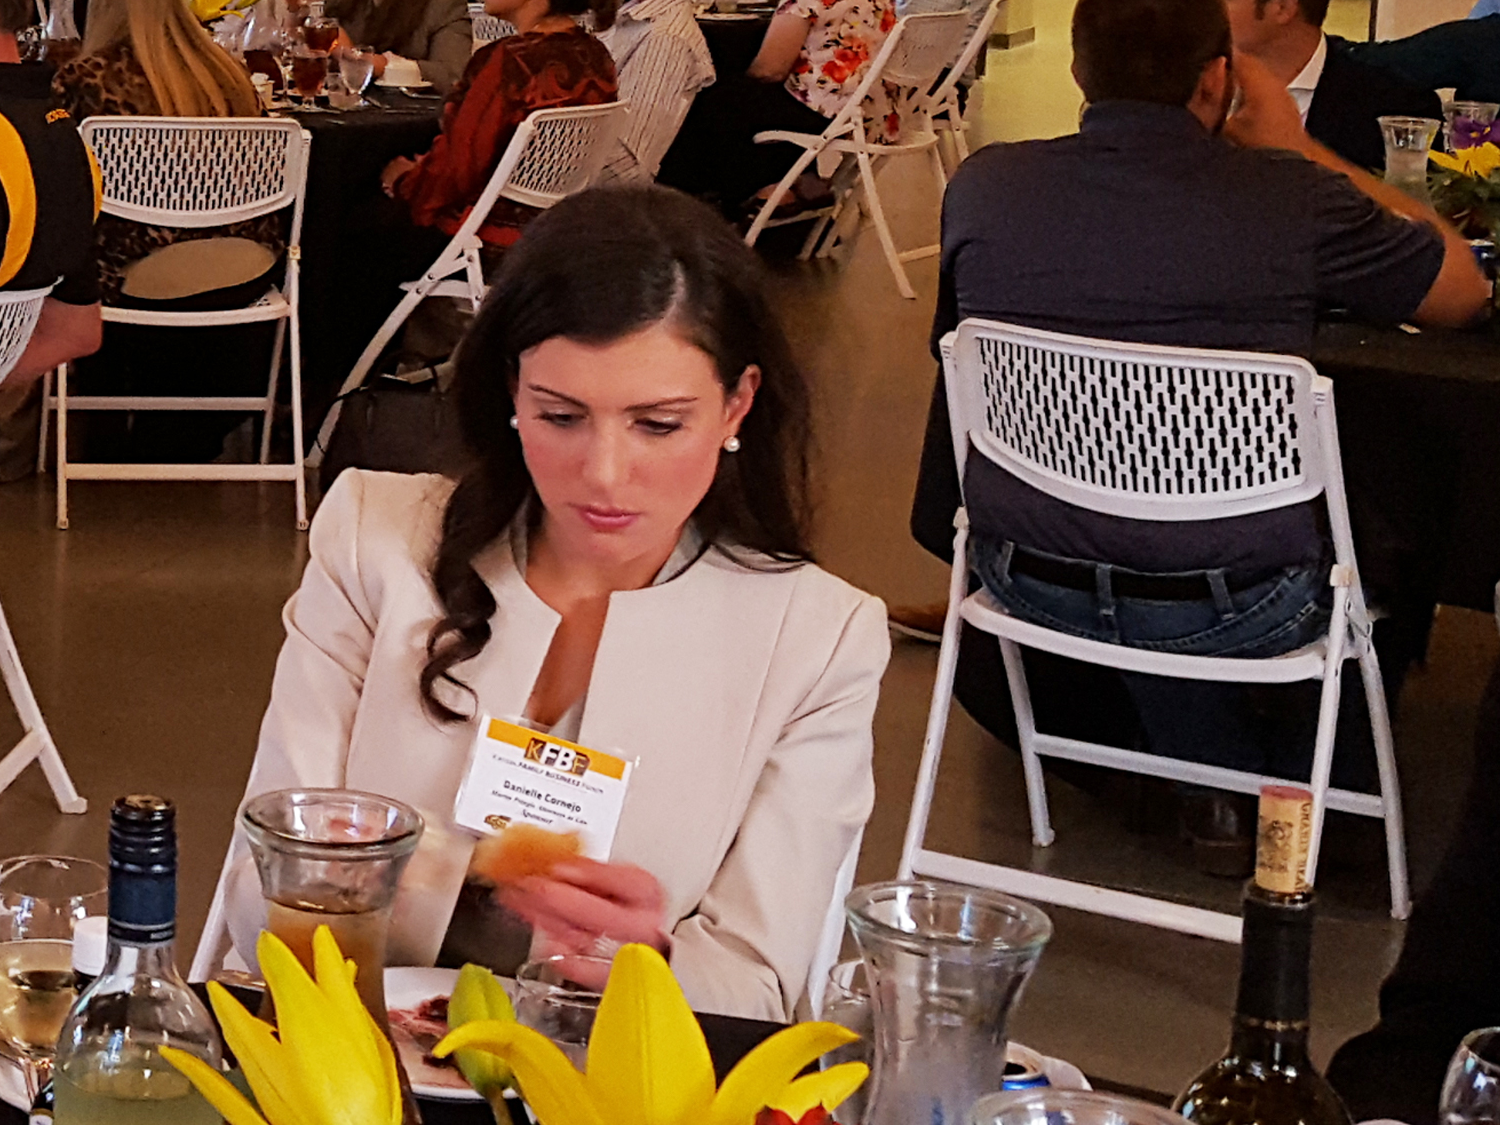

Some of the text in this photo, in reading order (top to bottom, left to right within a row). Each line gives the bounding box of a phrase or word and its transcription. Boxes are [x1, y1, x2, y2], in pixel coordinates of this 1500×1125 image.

[526, 739, 587, 773] KFBF
[503, 780, 542, 800] Danielle
[544, 794, 582, 813] Cornejo
